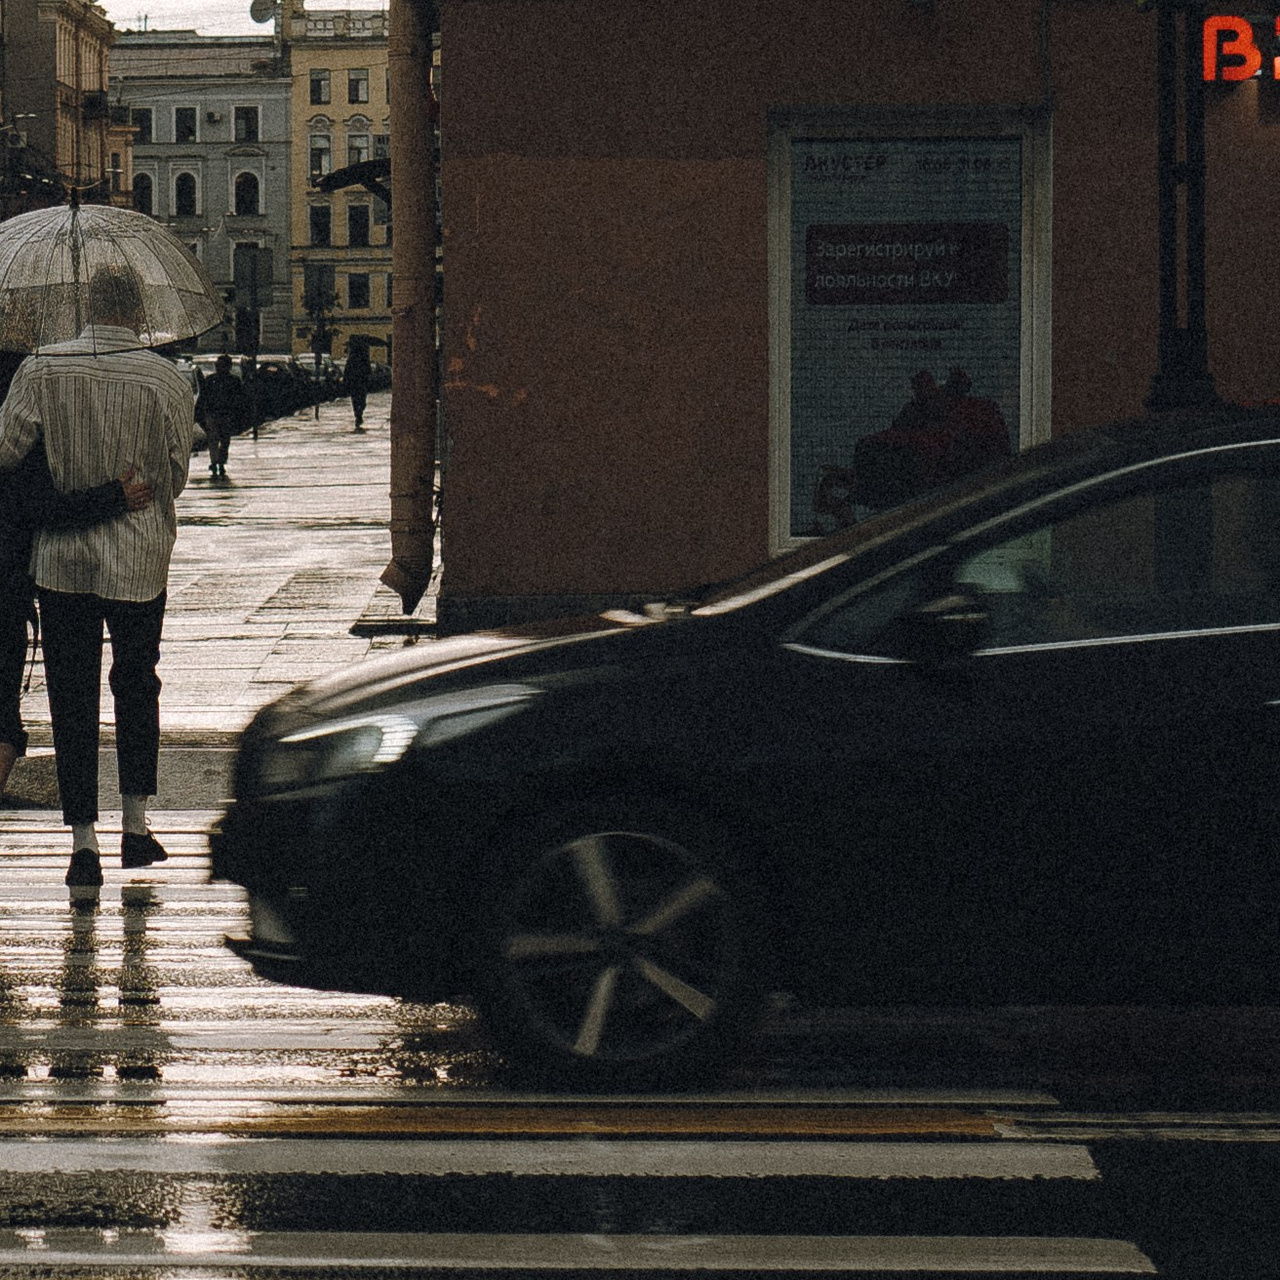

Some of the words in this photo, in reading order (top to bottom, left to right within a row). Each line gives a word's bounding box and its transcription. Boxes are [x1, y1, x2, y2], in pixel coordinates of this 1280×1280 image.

[1203, 15, 1280, 81] В
[815, 239, 946, 260] Зарегистрируй
[814, 272, 914, 289] лояльности
[919, 270, 957, 288] ВКУ
